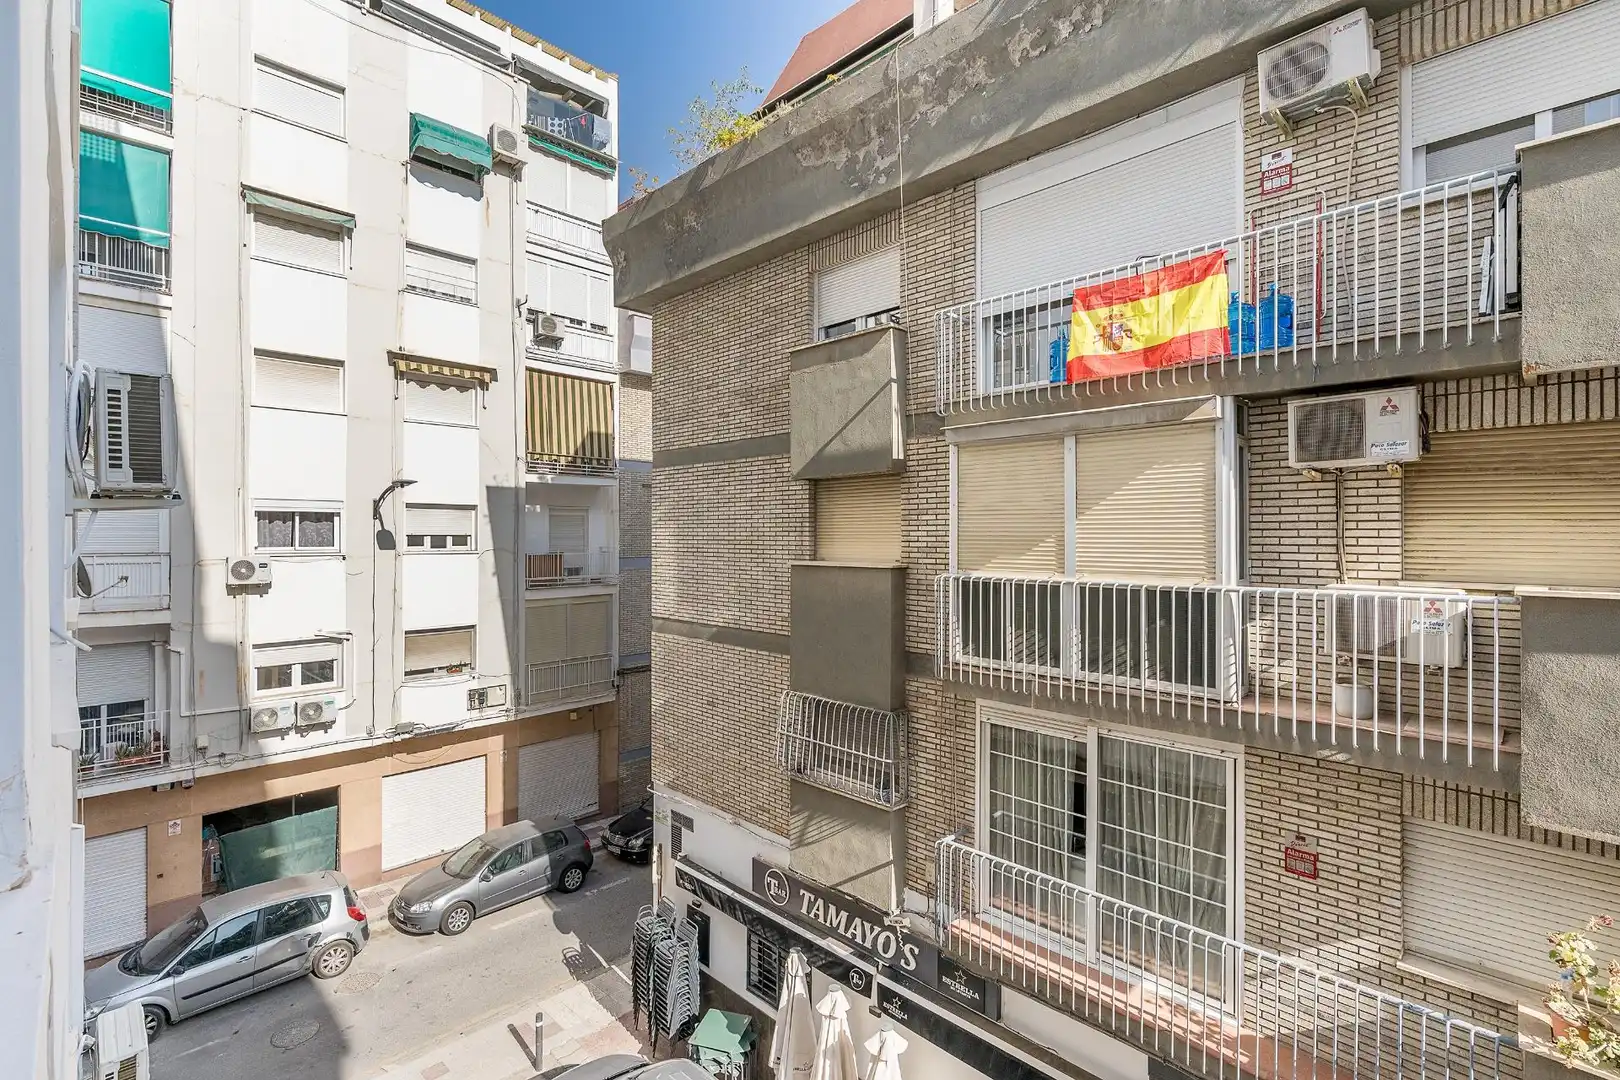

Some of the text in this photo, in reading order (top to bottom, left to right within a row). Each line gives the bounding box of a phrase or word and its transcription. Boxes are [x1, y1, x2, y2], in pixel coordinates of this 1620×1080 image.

[1264, 166, 1290, 178] Alarma
[1287, 848, 1314, 861] Alarma
[942, 975, 980, 1000] ESTRELLA
[883, 1001, 908, 1020] ESTRELLA
